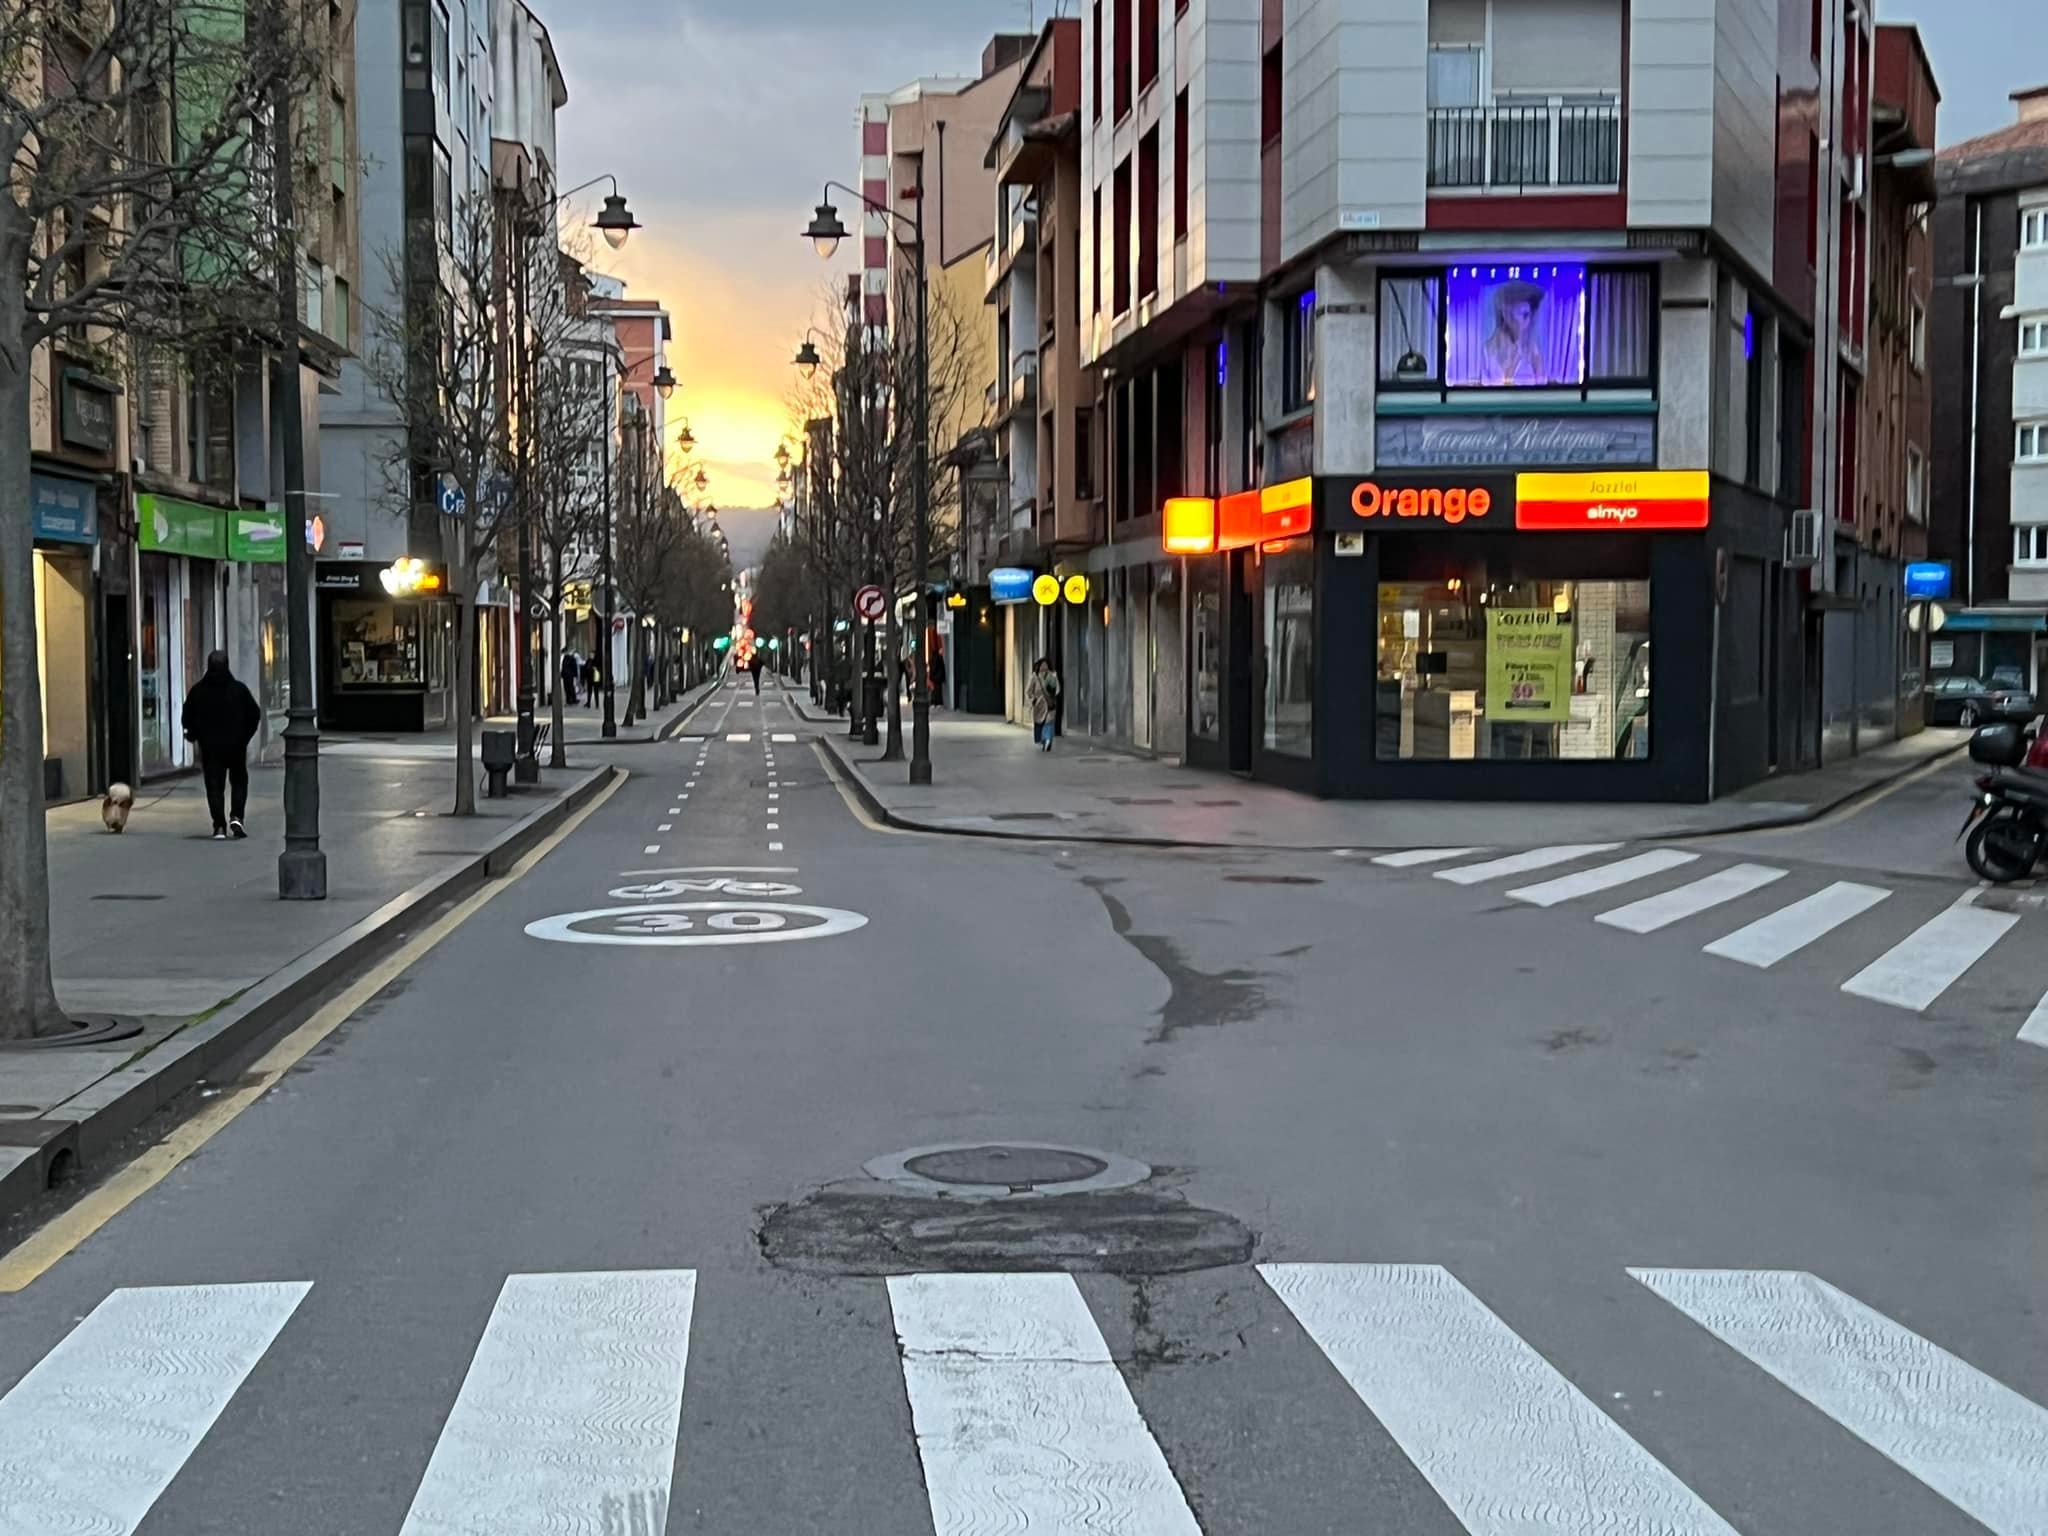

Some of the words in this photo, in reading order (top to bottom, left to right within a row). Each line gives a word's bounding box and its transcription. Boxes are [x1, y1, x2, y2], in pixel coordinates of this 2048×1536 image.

[1351, 481, 1491, 524] Orange
[1587, 504, 1639, 523] simyo
[613, 911, 787, 933] 30
